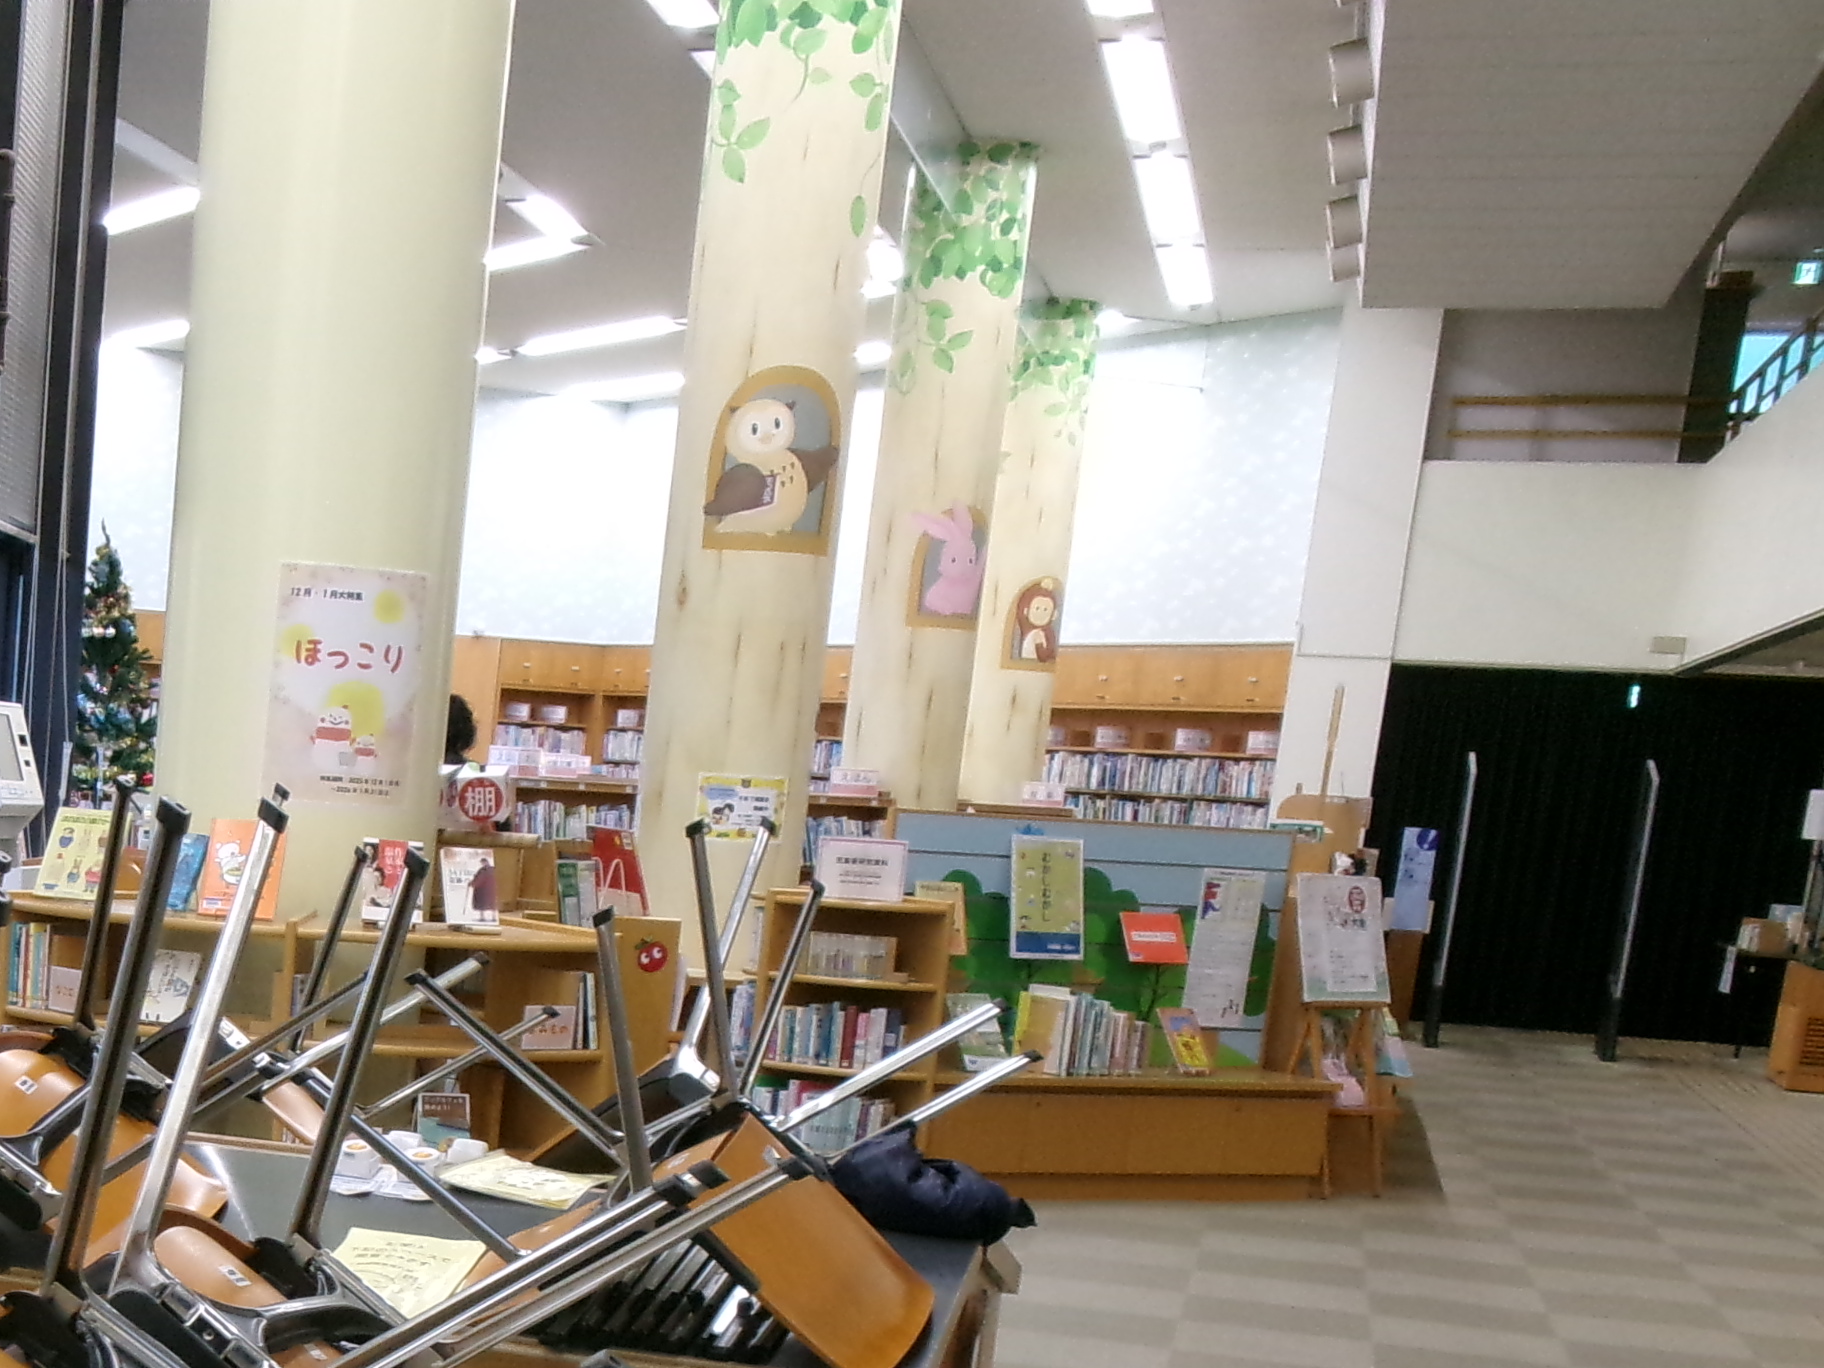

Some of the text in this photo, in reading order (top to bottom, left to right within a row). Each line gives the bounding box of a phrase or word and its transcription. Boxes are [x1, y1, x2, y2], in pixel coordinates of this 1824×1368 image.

[295, 638, 403, 674] ほっこり
[464, 786, 495, 817] 棚
[1041, 852, 1052, 922] むかしむかし
